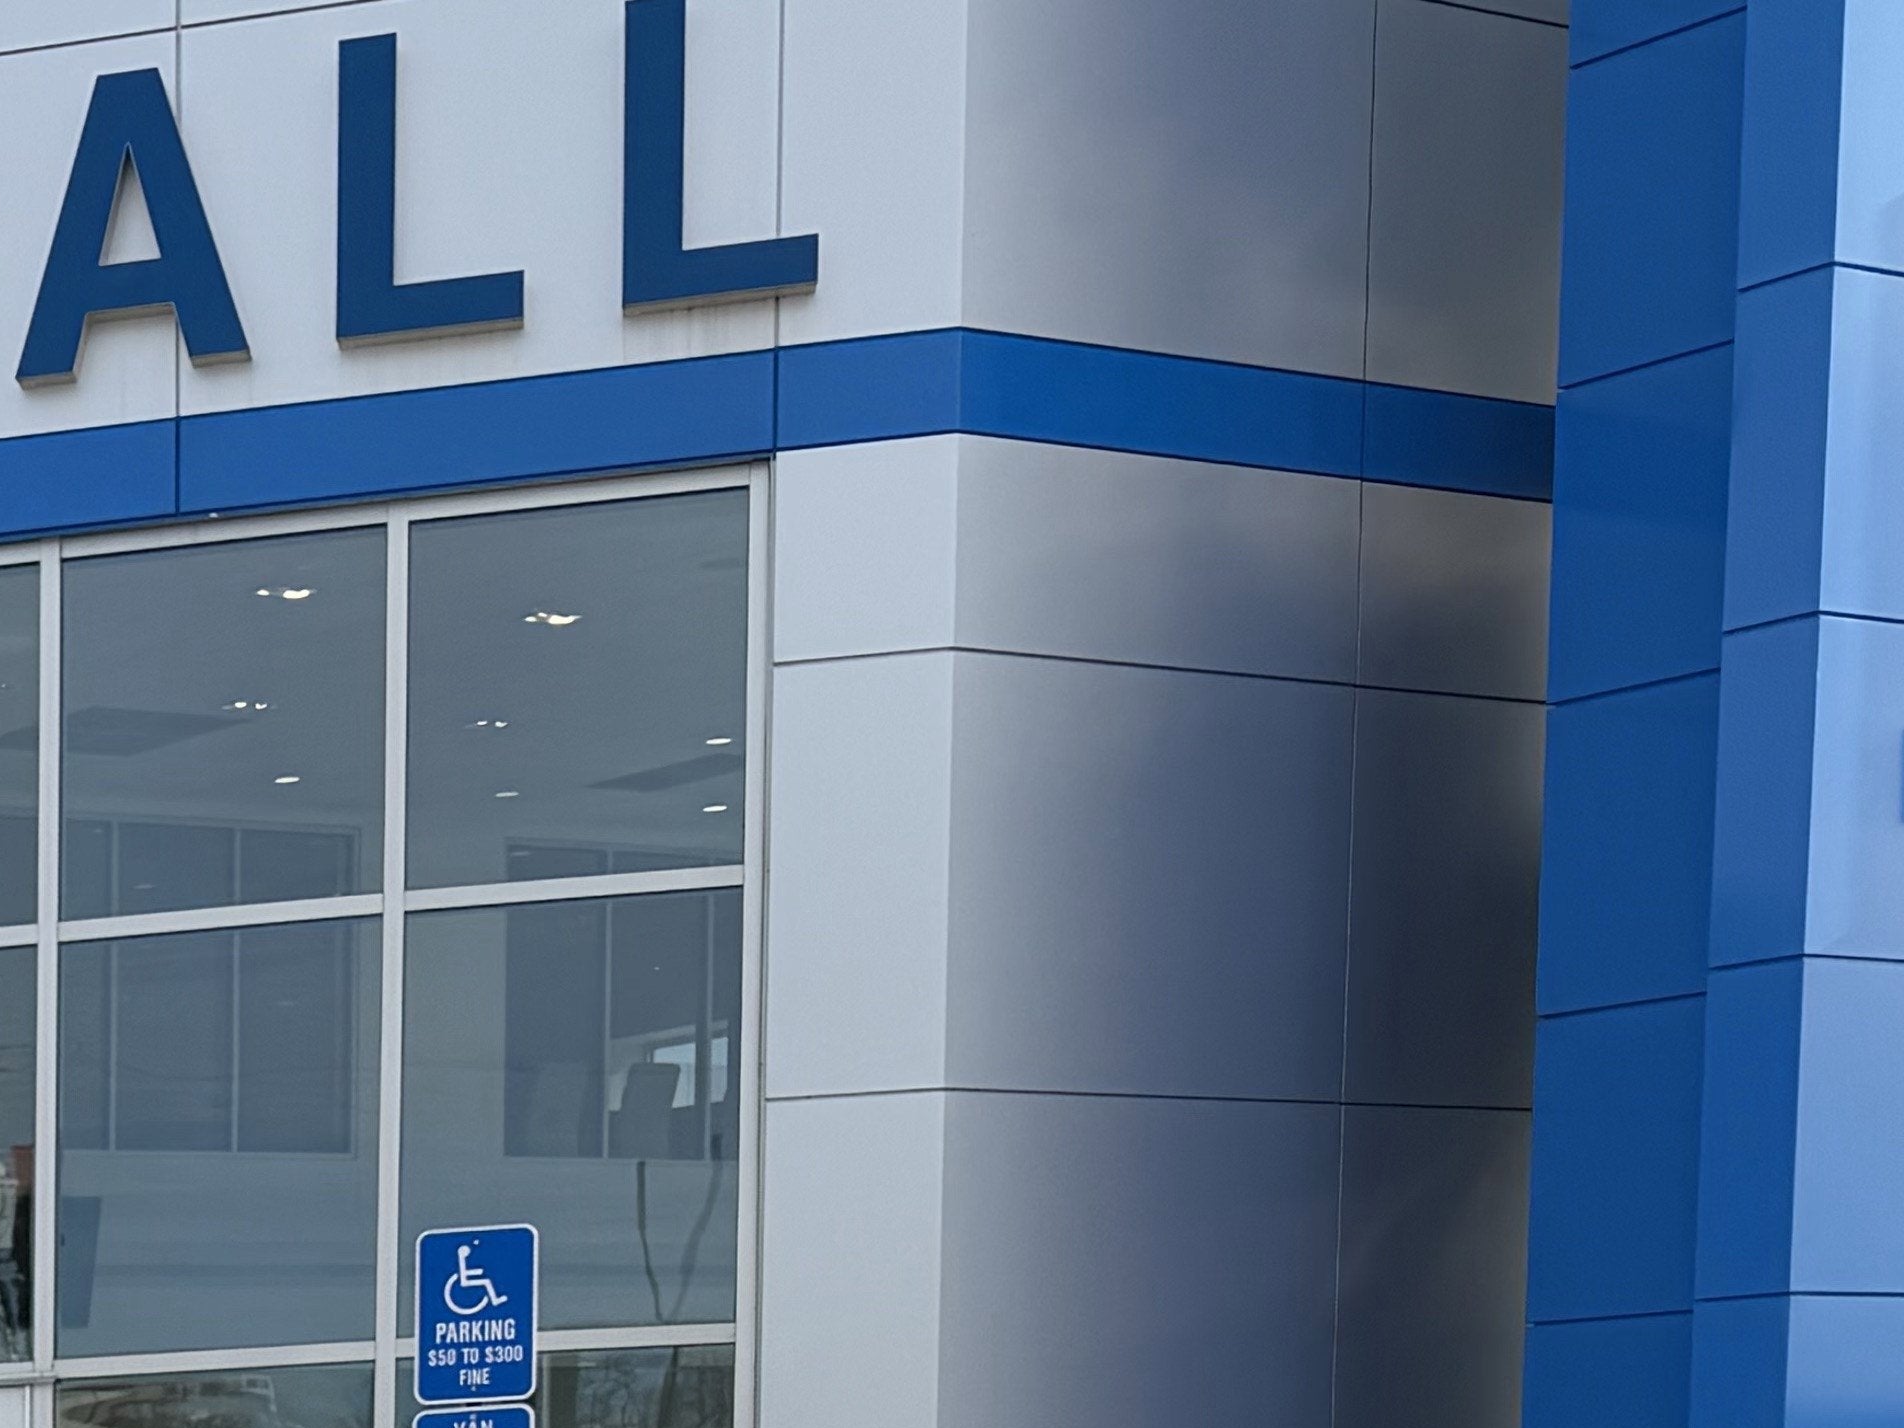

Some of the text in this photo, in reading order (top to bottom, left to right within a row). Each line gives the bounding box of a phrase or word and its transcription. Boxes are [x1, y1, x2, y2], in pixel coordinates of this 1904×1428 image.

[435, 1318, 516, 1344] PARKING
[428, 1344, 523, 1366] $50 TO $300
[459, 1367, 491, 1386] FINE
